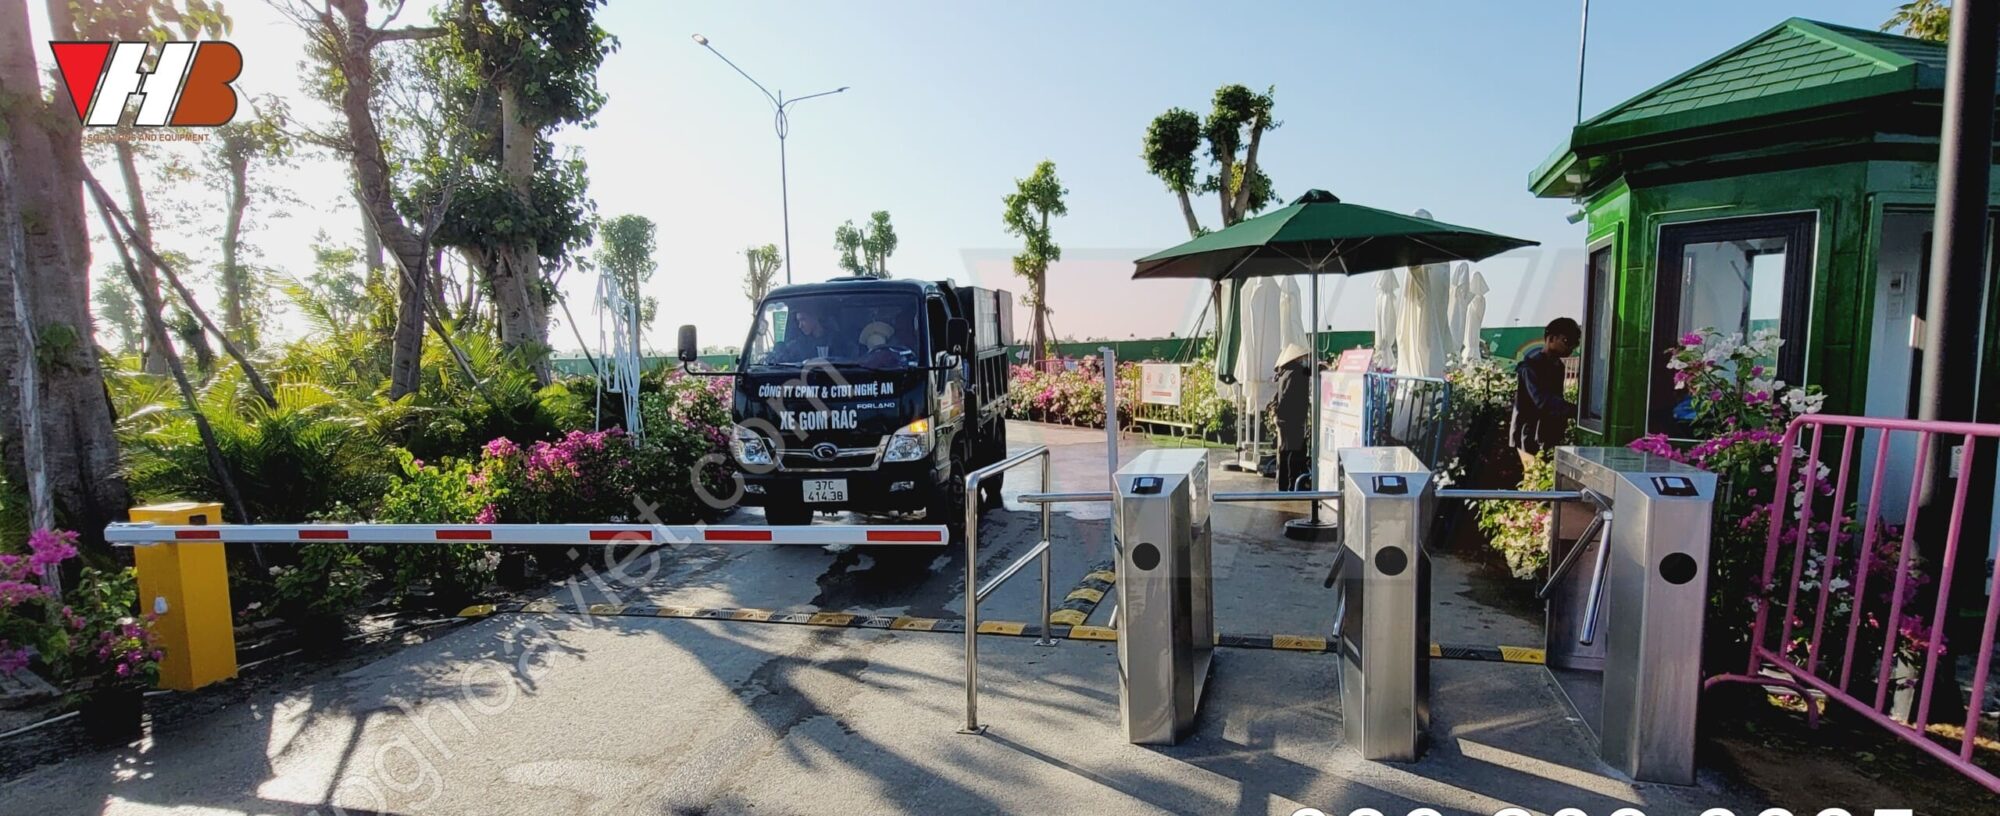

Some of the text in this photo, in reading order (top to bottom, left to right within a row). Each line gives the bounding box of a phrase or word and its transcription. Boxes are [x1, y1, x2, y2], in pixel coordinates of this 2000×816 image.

[783, 385, 793, 398] TY
[821, 386, 829, 398] &
[854, 381, 879, 397] NGHỆ
[880, 382, 894, 395] AN
[780, 406, 858, 430] XE GOM RÁC
[815, 480, 835, 491] 37C
